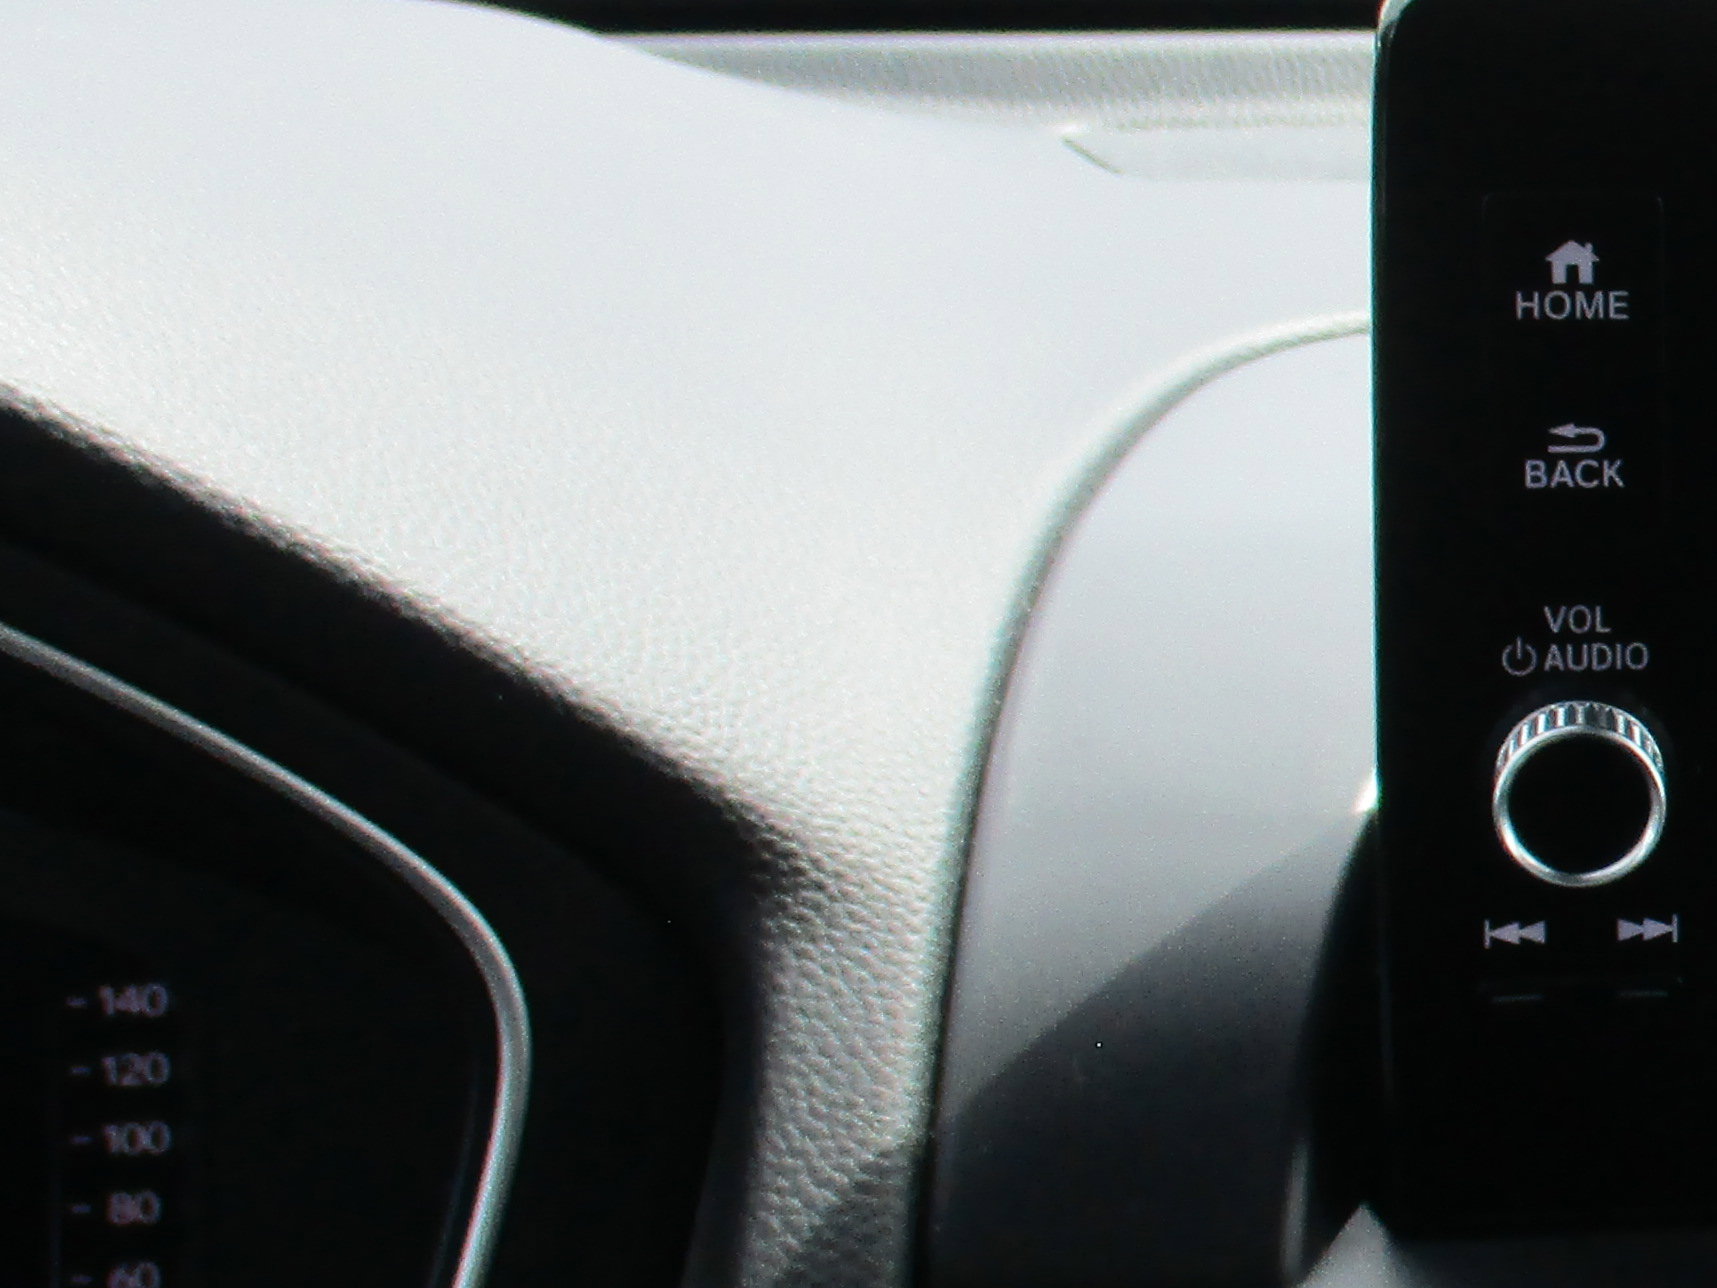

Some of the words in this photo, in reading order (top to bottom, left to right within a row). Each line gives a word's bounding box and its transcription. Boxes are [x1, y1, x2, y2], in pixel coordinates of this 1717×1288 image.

[1515, 290, 1629, 320] HOME
[1524, 458, 1624, 489] BACK
[1543, 604, 1612, 634] VOL
[1544, 642, 1649, 672] AUDIO
[99, 983, 170, 1017] 140
[101, 1051, 171, 1087] 120
[104, 1121, 172, 1154] 100
[108, 1191, 162, 1225] 80
